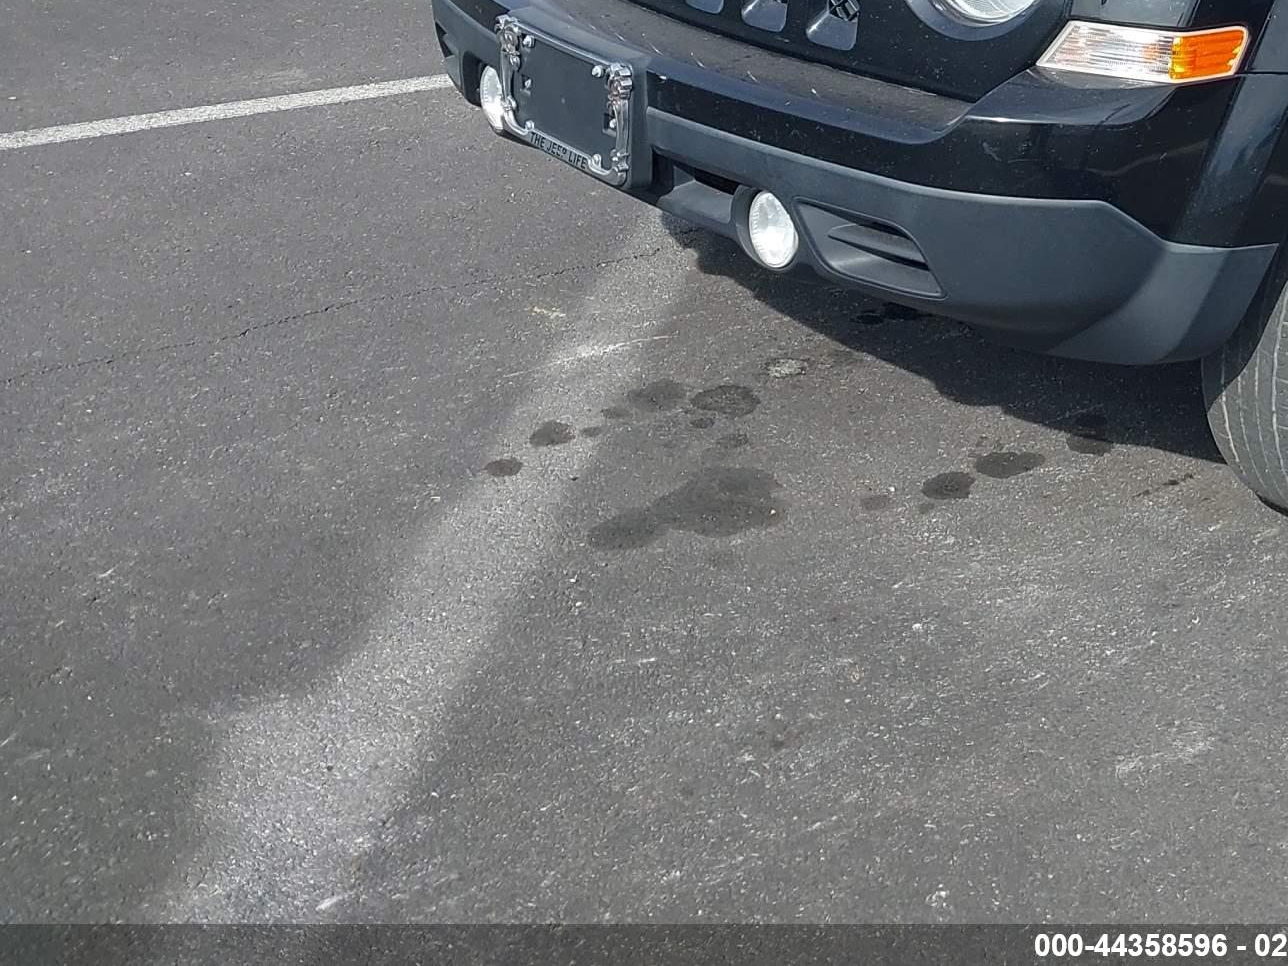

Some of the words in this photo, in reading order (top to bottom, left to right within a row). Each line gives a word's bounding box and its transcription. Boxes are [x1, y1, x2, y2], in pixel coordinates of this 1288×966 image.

[530, 132, 545, 148] THE
[546, 141, 567, 159] JEEP
[568, 150, 588, 169] LIFE
